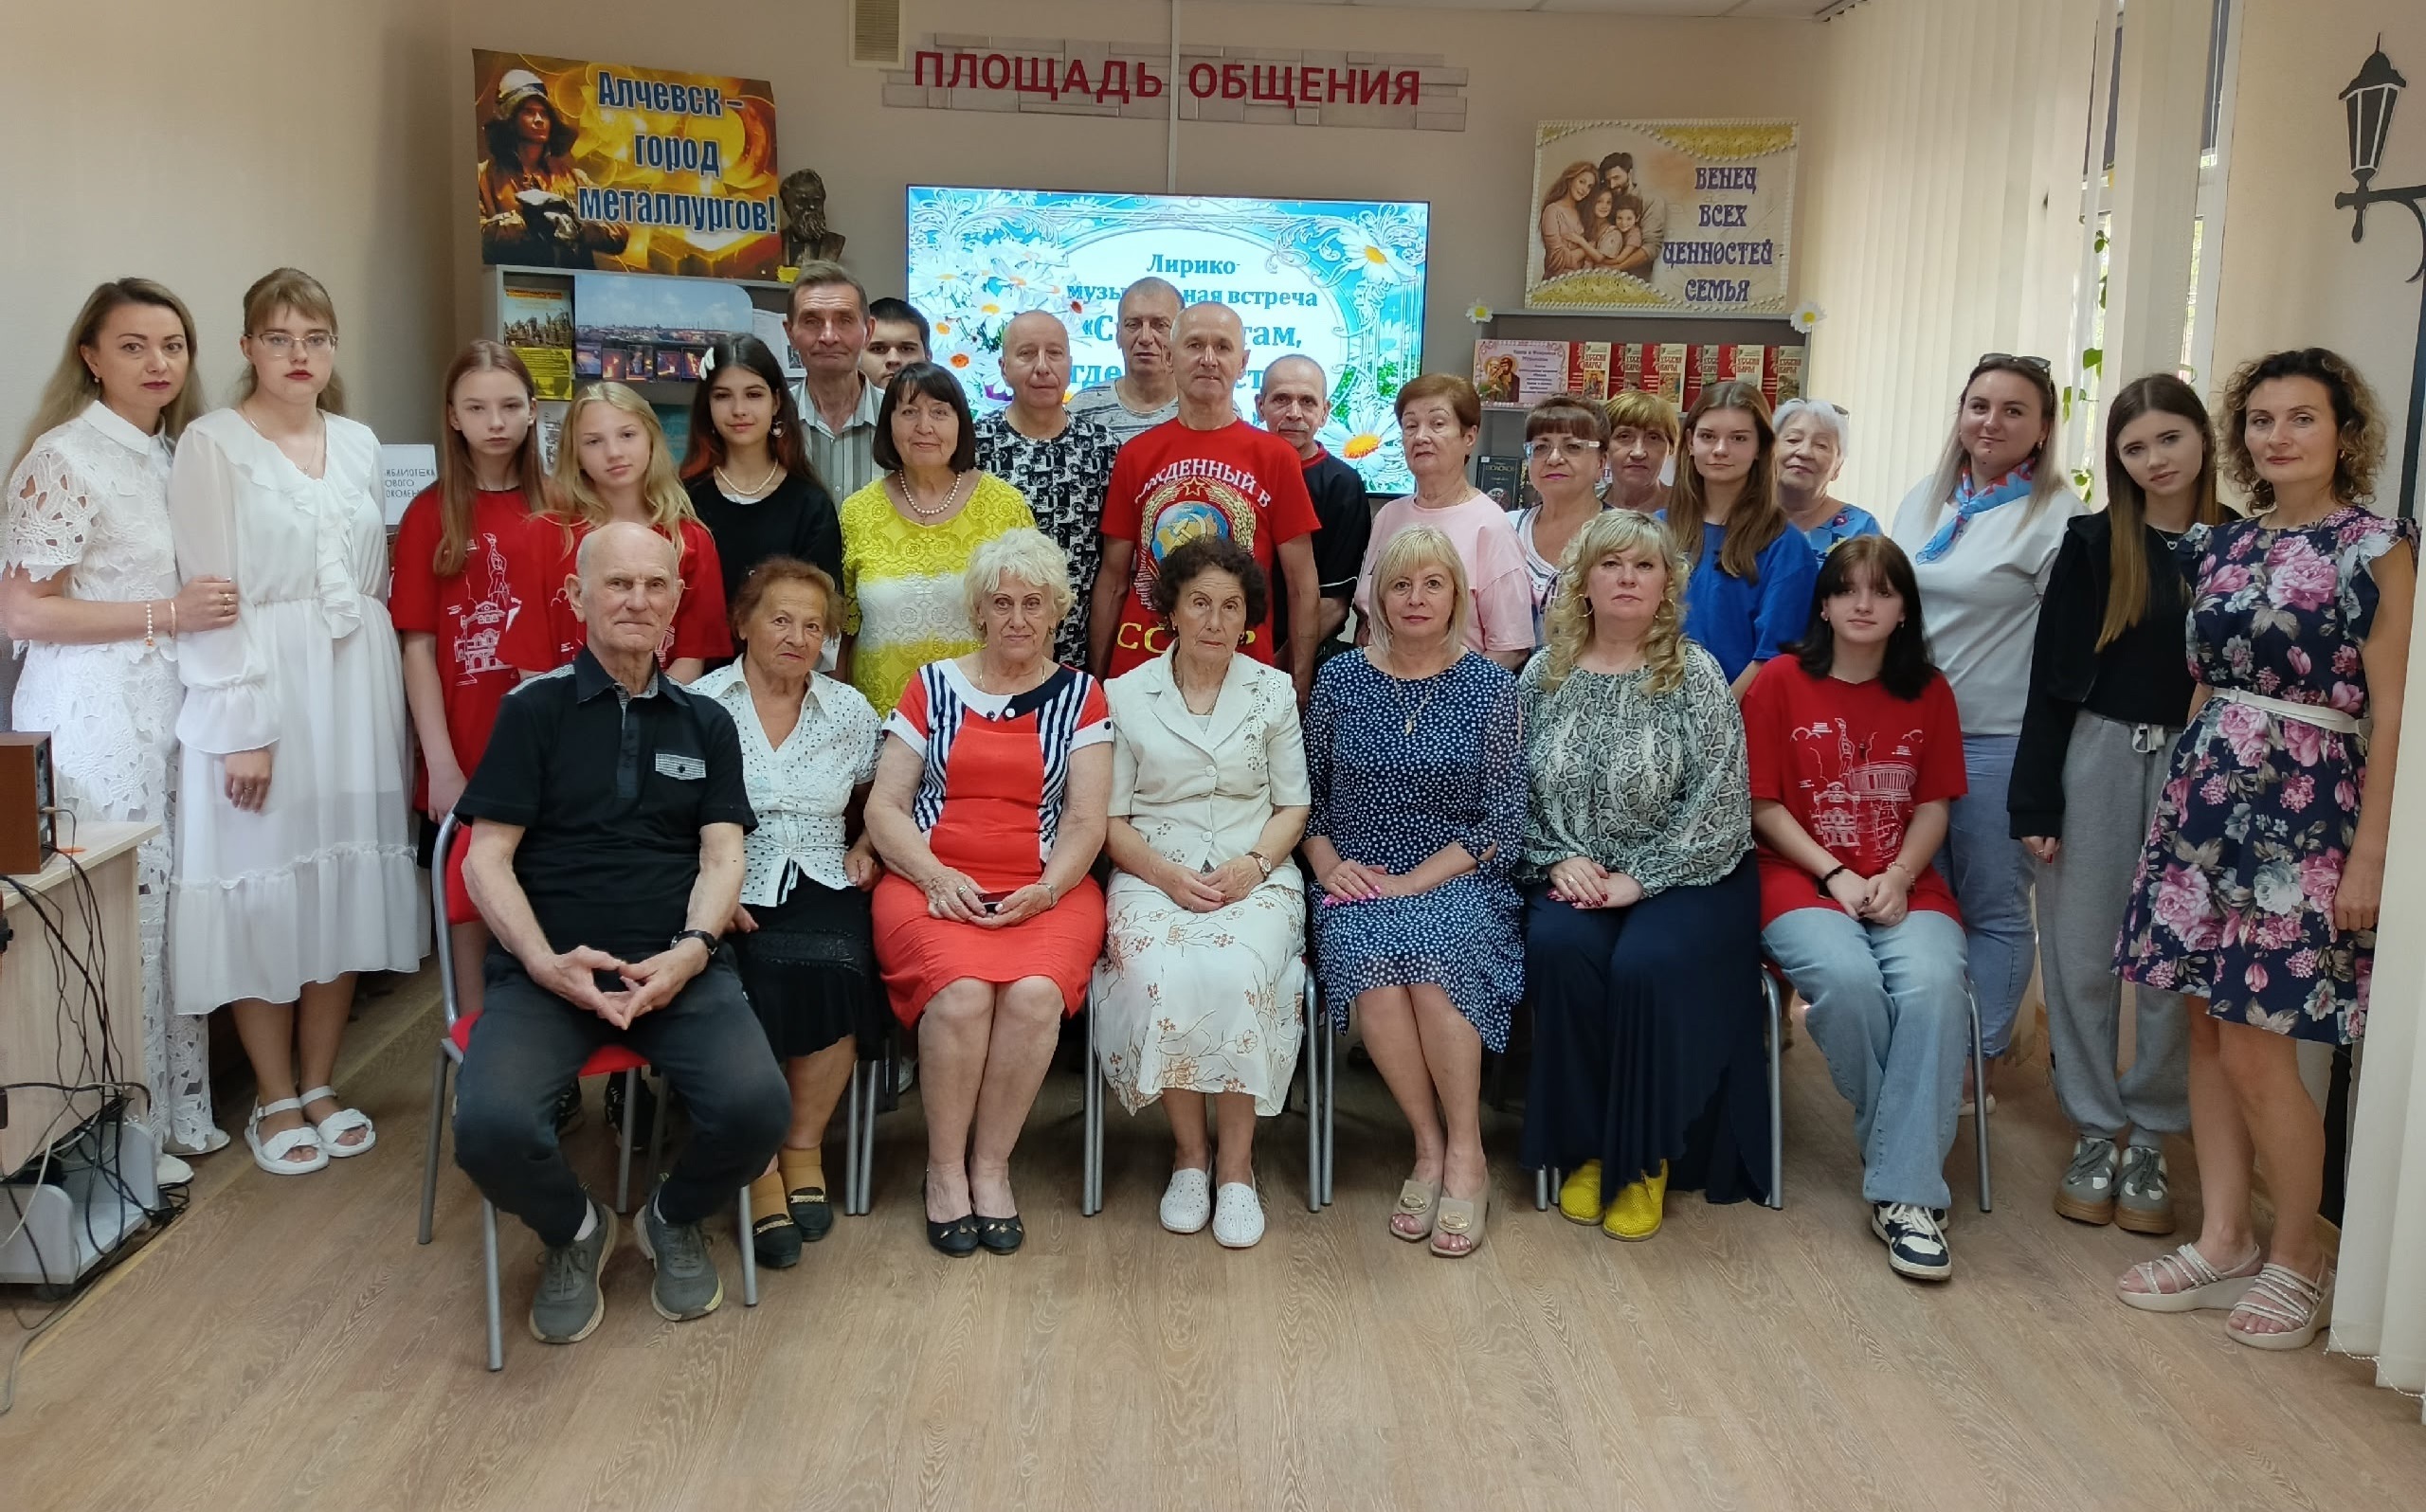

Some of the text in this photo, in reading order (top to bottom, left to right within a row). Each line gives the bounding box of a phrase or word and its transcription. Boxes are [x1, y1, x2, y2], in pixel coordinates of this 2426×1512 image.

[914, 50, 1421, 109] ПЛОЩАДЬ ОБЩЕНИЯ
[598, 71, 721, 117] Алчевск
[634, 134, 720, 177] город
[1694, 166, 1757, 194] ВЕНЕЦ
[578, 187, 777, 234] металлургов!
[1698, 204, 1747, 227] ВСЕХ
[1662, 238, 1773, 270] ЦЕННОСТЕЙ
[1227, 291, 1318, 310] встреча
[1684, 278, 1750, 302] СЕМЬЯ
[1071, 365, 1122, 389] где
[384, 468, 436, 477] ИБЛИОТЕКА
[1257, 488, 1272, 508] В
